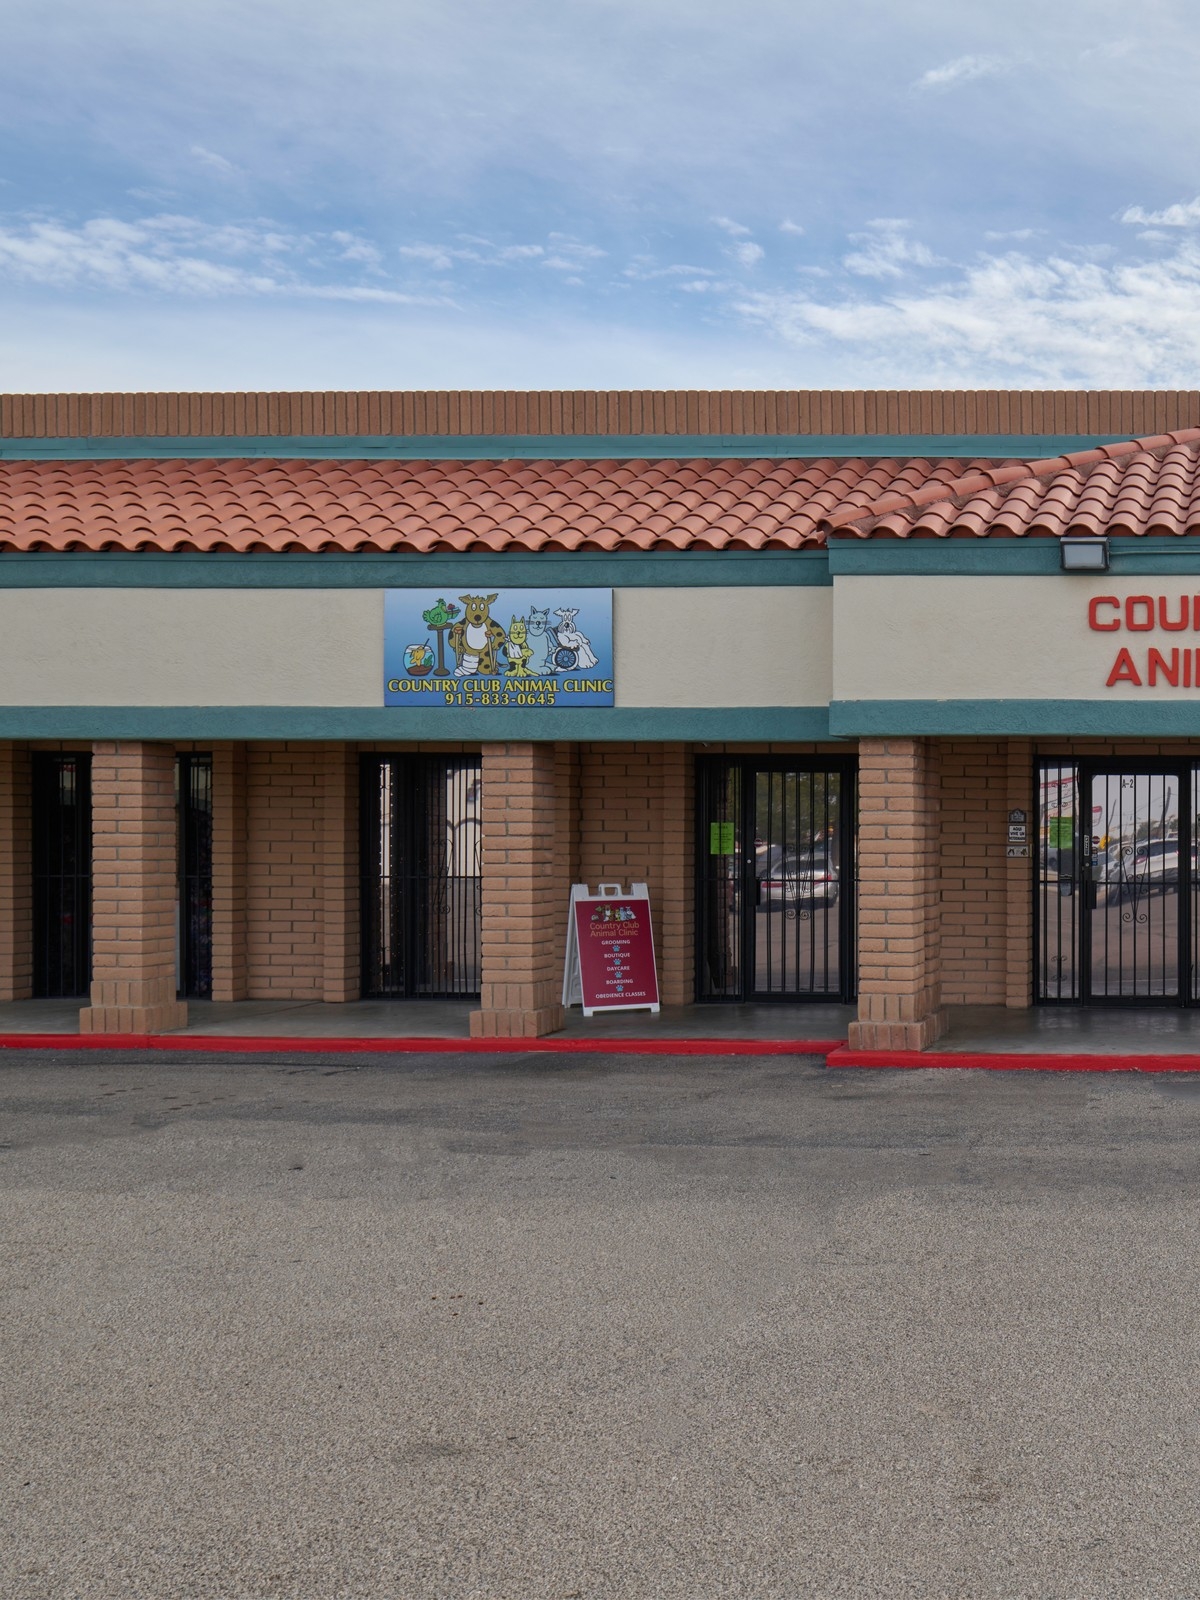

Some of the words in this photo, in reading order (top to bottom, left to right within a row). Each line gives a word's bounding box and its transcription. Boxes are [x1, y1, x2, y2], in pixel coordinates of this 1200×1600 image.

[387, 679, 460, 693] COUNTRY
[462, 679, 501, 692] CLUB
[503, 679, 560, 693] ANIMAL
[562, 679, 614, 692] CLINIC
[444, 692, 556, 705] 915-833-0645
[589, 922, 621, 930] Country
